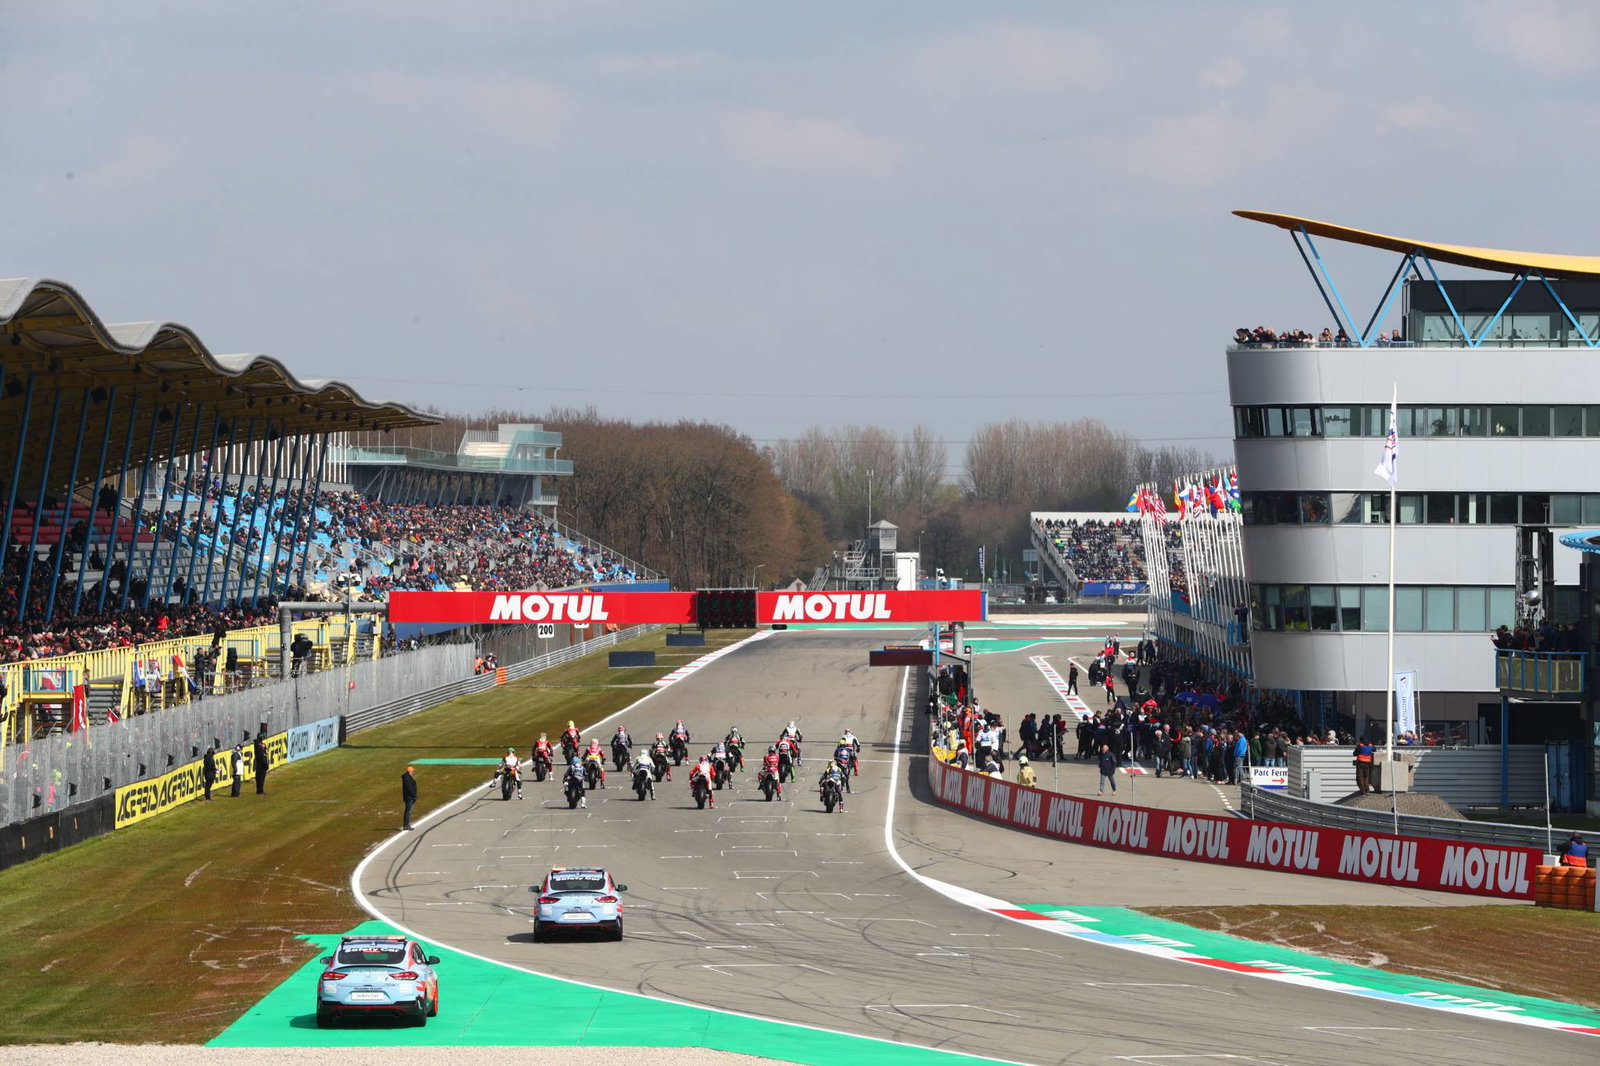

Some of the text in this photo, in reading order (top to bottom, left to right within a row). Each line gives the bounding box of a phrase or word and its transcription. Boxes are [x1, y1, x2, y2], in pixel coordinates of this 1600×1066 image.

[489, 594, 609, 621] MOTUL
[772, 593, 892, 620] MOTUL
[538, 624, 553, 635] 200
[1253, 768, 1269, 776] Parc
[117, 784, 158, 822] ACERBIS
[160, 769, 195, 807] ACERBIS
[988, 781, 1010, 820] MOTUL
[1014, 788, 1042, 828] MOTUL
[1046, 797, 1084, 838] MOTUL
[1092, 806, 1149, 848] MOTUL
[1162, 815, 1230, 859] MOTUL
[1246, 825, 1319, 870] MOTUL
[1338, 835, 1420, 882] MOTUL
[1440, 845, 1530, 894] MOTUL
